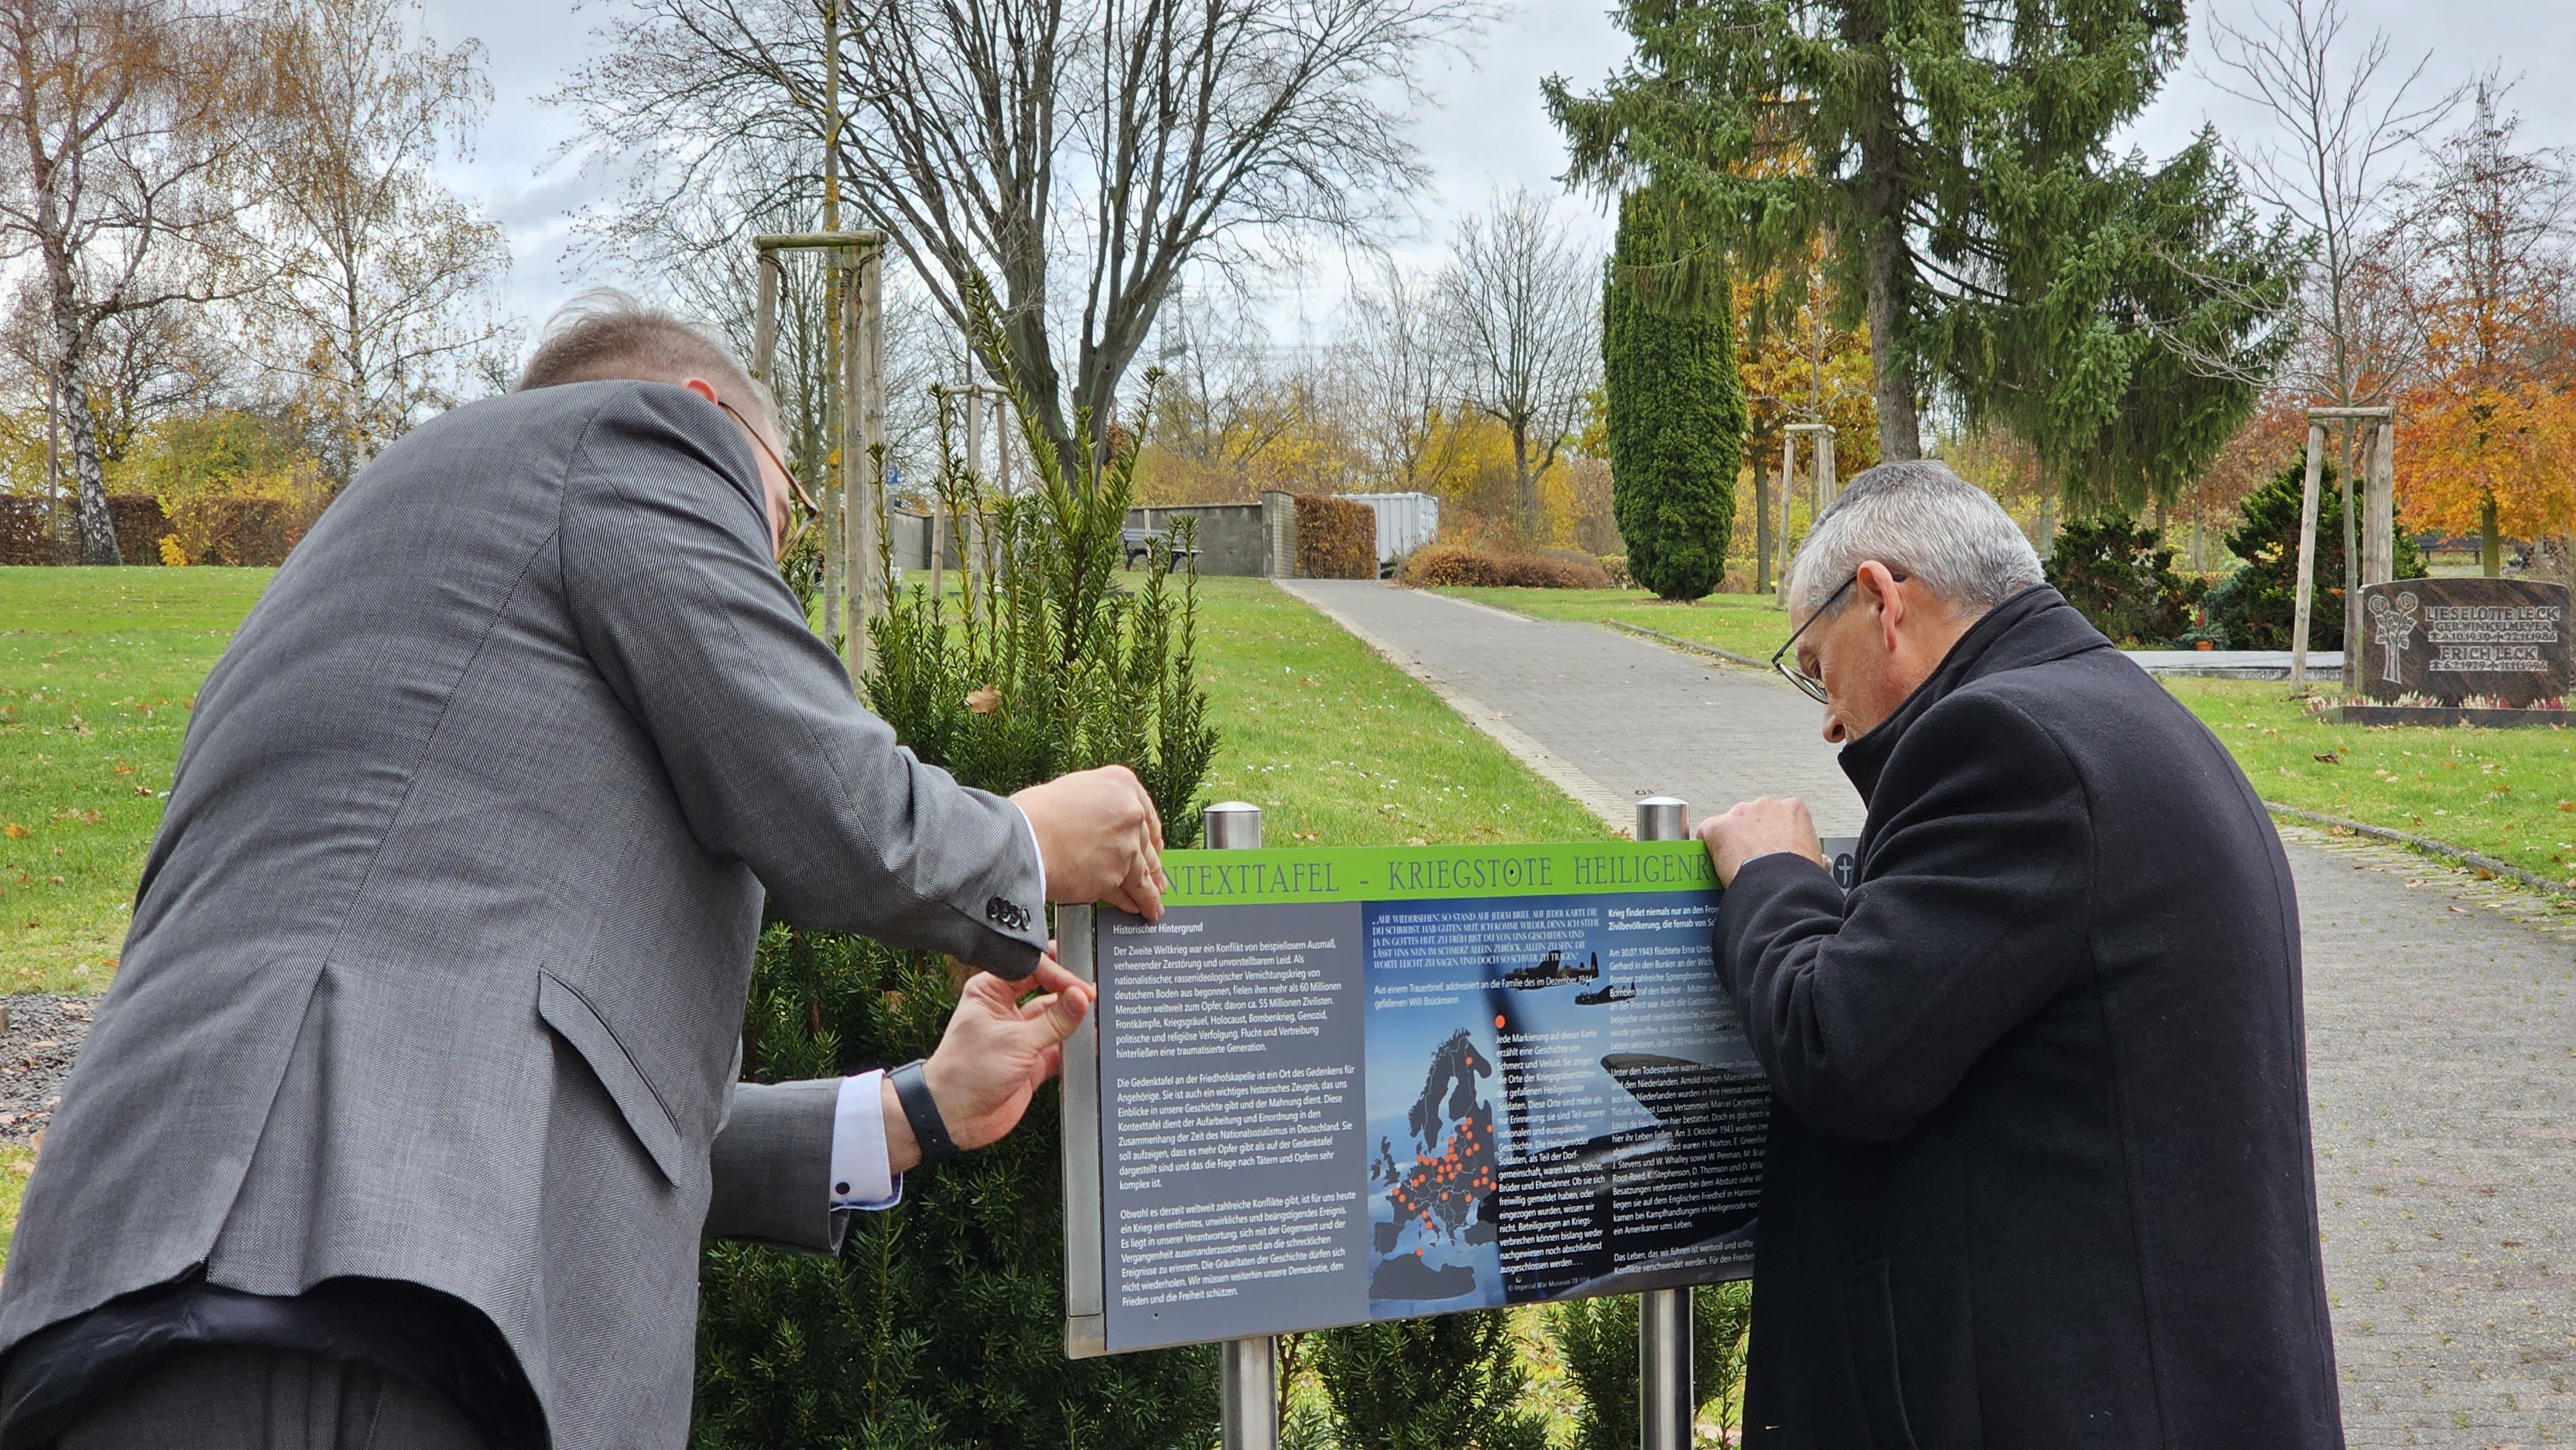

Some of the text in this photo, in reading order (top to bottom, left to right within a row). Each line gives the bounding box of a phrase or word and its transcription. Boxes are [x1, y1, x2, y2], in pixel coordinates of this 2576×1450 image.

[2427, 607, 2559, 621] LIESELOTTE LECK
[2442, 646, 2537, 660] ERICH LECK
[1162, 863, 1340, 895] NTEXTTAFEL
[1388, 857, 1553, 890] KRIEGSTOTE
[1574, 853, 1711, 885] HEILIGENR
[1608, 909, 1624, 919] Krieg
[1625, 907, 1645, 916] findet
[1646, 907, 1669, 916] niemals
[1692, 905, 1703, 914] den
[1705, 905, 1718, 913] Fron
[1113, 922, 1202, 934] Historischer Hintergrund
[1113, 946, 1127, 956] Der
[1128, 945, 1151, 956] Zweite
[1153, 945, 1187, 956] Weltkrieg
[1203, 943, 1214, 953] ein
[1216, 942, 1243, 952] Konflikt
[1259, 941, 1306, 952] beispiellosem
[1307, 939, 1336, 948] Ausmaß,
[1113, 954, 1304, 970] verheerender Zerstörung und unvorstellbarem Leid. Als
[1114, 974, 1172, 984] nationalistischer,
[1174, 972, 1243, 983] rassenideologischer
[1244, 968, 1305, 981] Vernichtungskrieg
[1374, 985, 1387, 993] Aus
[1387, 984, 1408, 993] einem
[1490, 979, 1500, 988] die
[1501, 978, 1522, 987] Familie
[1524, 977, 1535, 986] des
[1536, 977, 1544, 986] im
[1546, 974, 1578, 985] Dezember
[1115, 990, 1154, 999] deutschem
[1155, 988, 1179, 998] Boden
[1194, 987, 1231, 999] begonnen,
[1233, 984, 1253, 994] fielen
[1254, 984, 1267, 993] ihm
[1269, 983, 1287, 993] mehr
[1289, 983, 1298, 992] als
[1300, 982, 1309, 992] 60
[1310, 982, 1341, 991] Millionen
[1115, 1004, 1151, 1014] Menschen
[1153, 1003, 1183, 1012] weltweit
[1201, 1001, 1222, 1012] Opfer,
[1224, 1000, 1245, 1010] davon
[1258, 998, 1267, 1008] 55
[1269, 998, 1302, 1007] Millionen
[1302, 997, 1334, 1006] Zivilisten.
[1374, 998, 1407, 1010] gefallenen
[1424, 996, 1459, 1005] Brückmann
[1115, 1010, 1327, 1030] Frontkämpfe, Kriegsgräuel, Holocaust, Bombenkrieg, Genozid,
[1116, 1025, 1318, 1046] politische und religiöse Verfolgung, Flucht und Vertreibung
[1116, 1042, 1267, 1058] hinterließen eine traumatisierte Generation.
[1117, 1078, 1129, 1088] Die
[1131, 1076, 1173, 1087] Gedenktafel
[1186, 1074, 1198, 1084] der
[1199, 1071, 1255, 1082] Friedhofskapelle
[1256, 1071, 1265, 1079] ist
[1267, 1069, 1277, 1078] ein
[1278, 1069, 1291, 1078] Ort
[1292, 1068, 1304, 1077] des
[1305, 1066, 1343, 1077] Gedenkens
[1344, 1064, 1354, 1073] für
[1498, 1166, 1542, 1181] gemeinschaft,
[1499, 1182, 1520, 1192] Brüder
[1521, 1181, 1534, 1190] und
[1572, 1176, 1582, 1185] Ob
[1583, 1176, 1592, 1185] sie
[1593, 1174, 1605, 1183] sich
[1499, 1201, 1595, 1221] eingezogen wurden, wissen wir
[1635, 1210, 1644, 1219] bei
[1646, 1207, 1700, 1219] Kampfhandlungen
[1709, 1201, 1747, 1213] Heiligenrode
[1499, 1228, 1603, 1246] verbrechen können bislang weder
[1613, 1227, 1623, 1236] ein
[1624, 1224, 1658, 1234] Amerikaner
[1500, 1241, 1602, 1261] nachgewiesen noch abschließend
[1500, 1262, 1549, 1274] ausgeschlossen
[1549, 1258, 1573, 1268] werden
[1122, 1288, 1238, 1306] Frieden und die Freiheit schützen.
